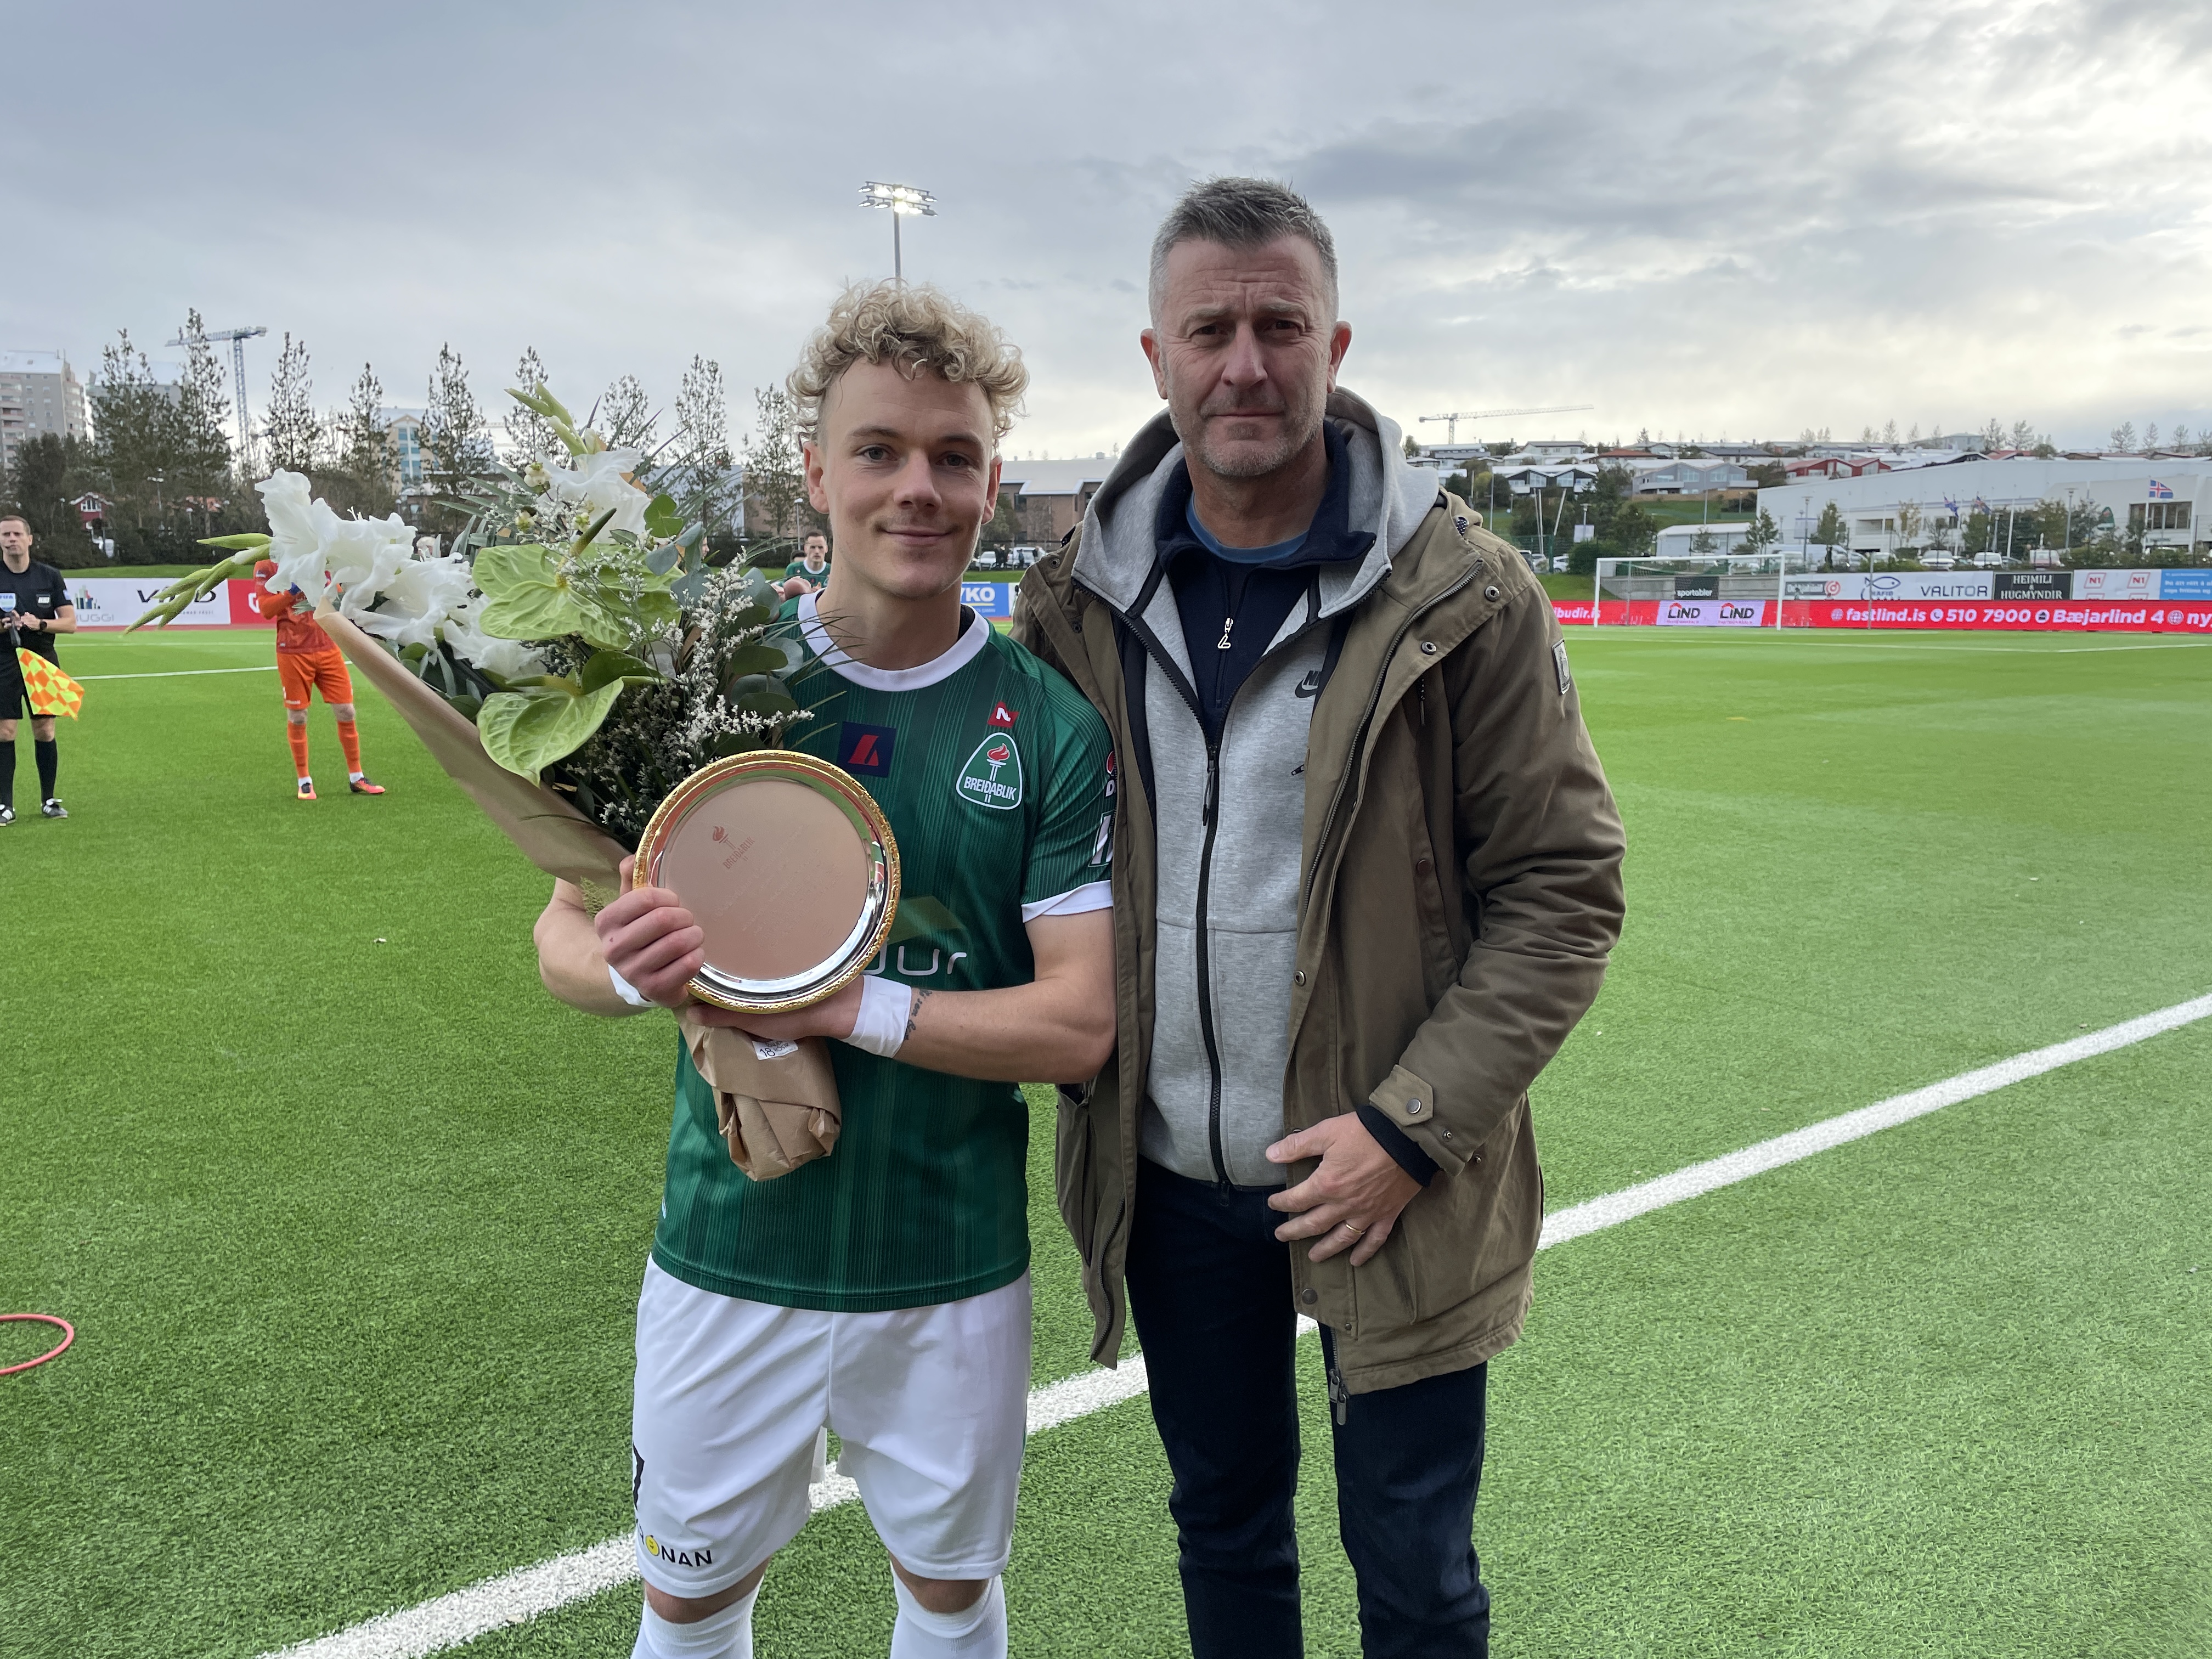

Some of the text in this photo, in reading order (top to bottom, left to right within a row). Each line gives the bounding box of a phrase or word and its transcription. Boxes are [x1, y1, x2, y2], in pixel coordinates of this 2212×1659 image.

[2013, 575, 2052, 584] HEIMILI
[1921, 585, 1988, 597] VALITOR
[2001, 590, 2063, 600] HUGMYNDIR
[1847, 608, 2212, 628] fastlind.is 510 7900 Bæjarlind 4 ny
[1303, 670, 1322, 686] NI
[963, 776, 1017, 801] BREIÐABLIK
